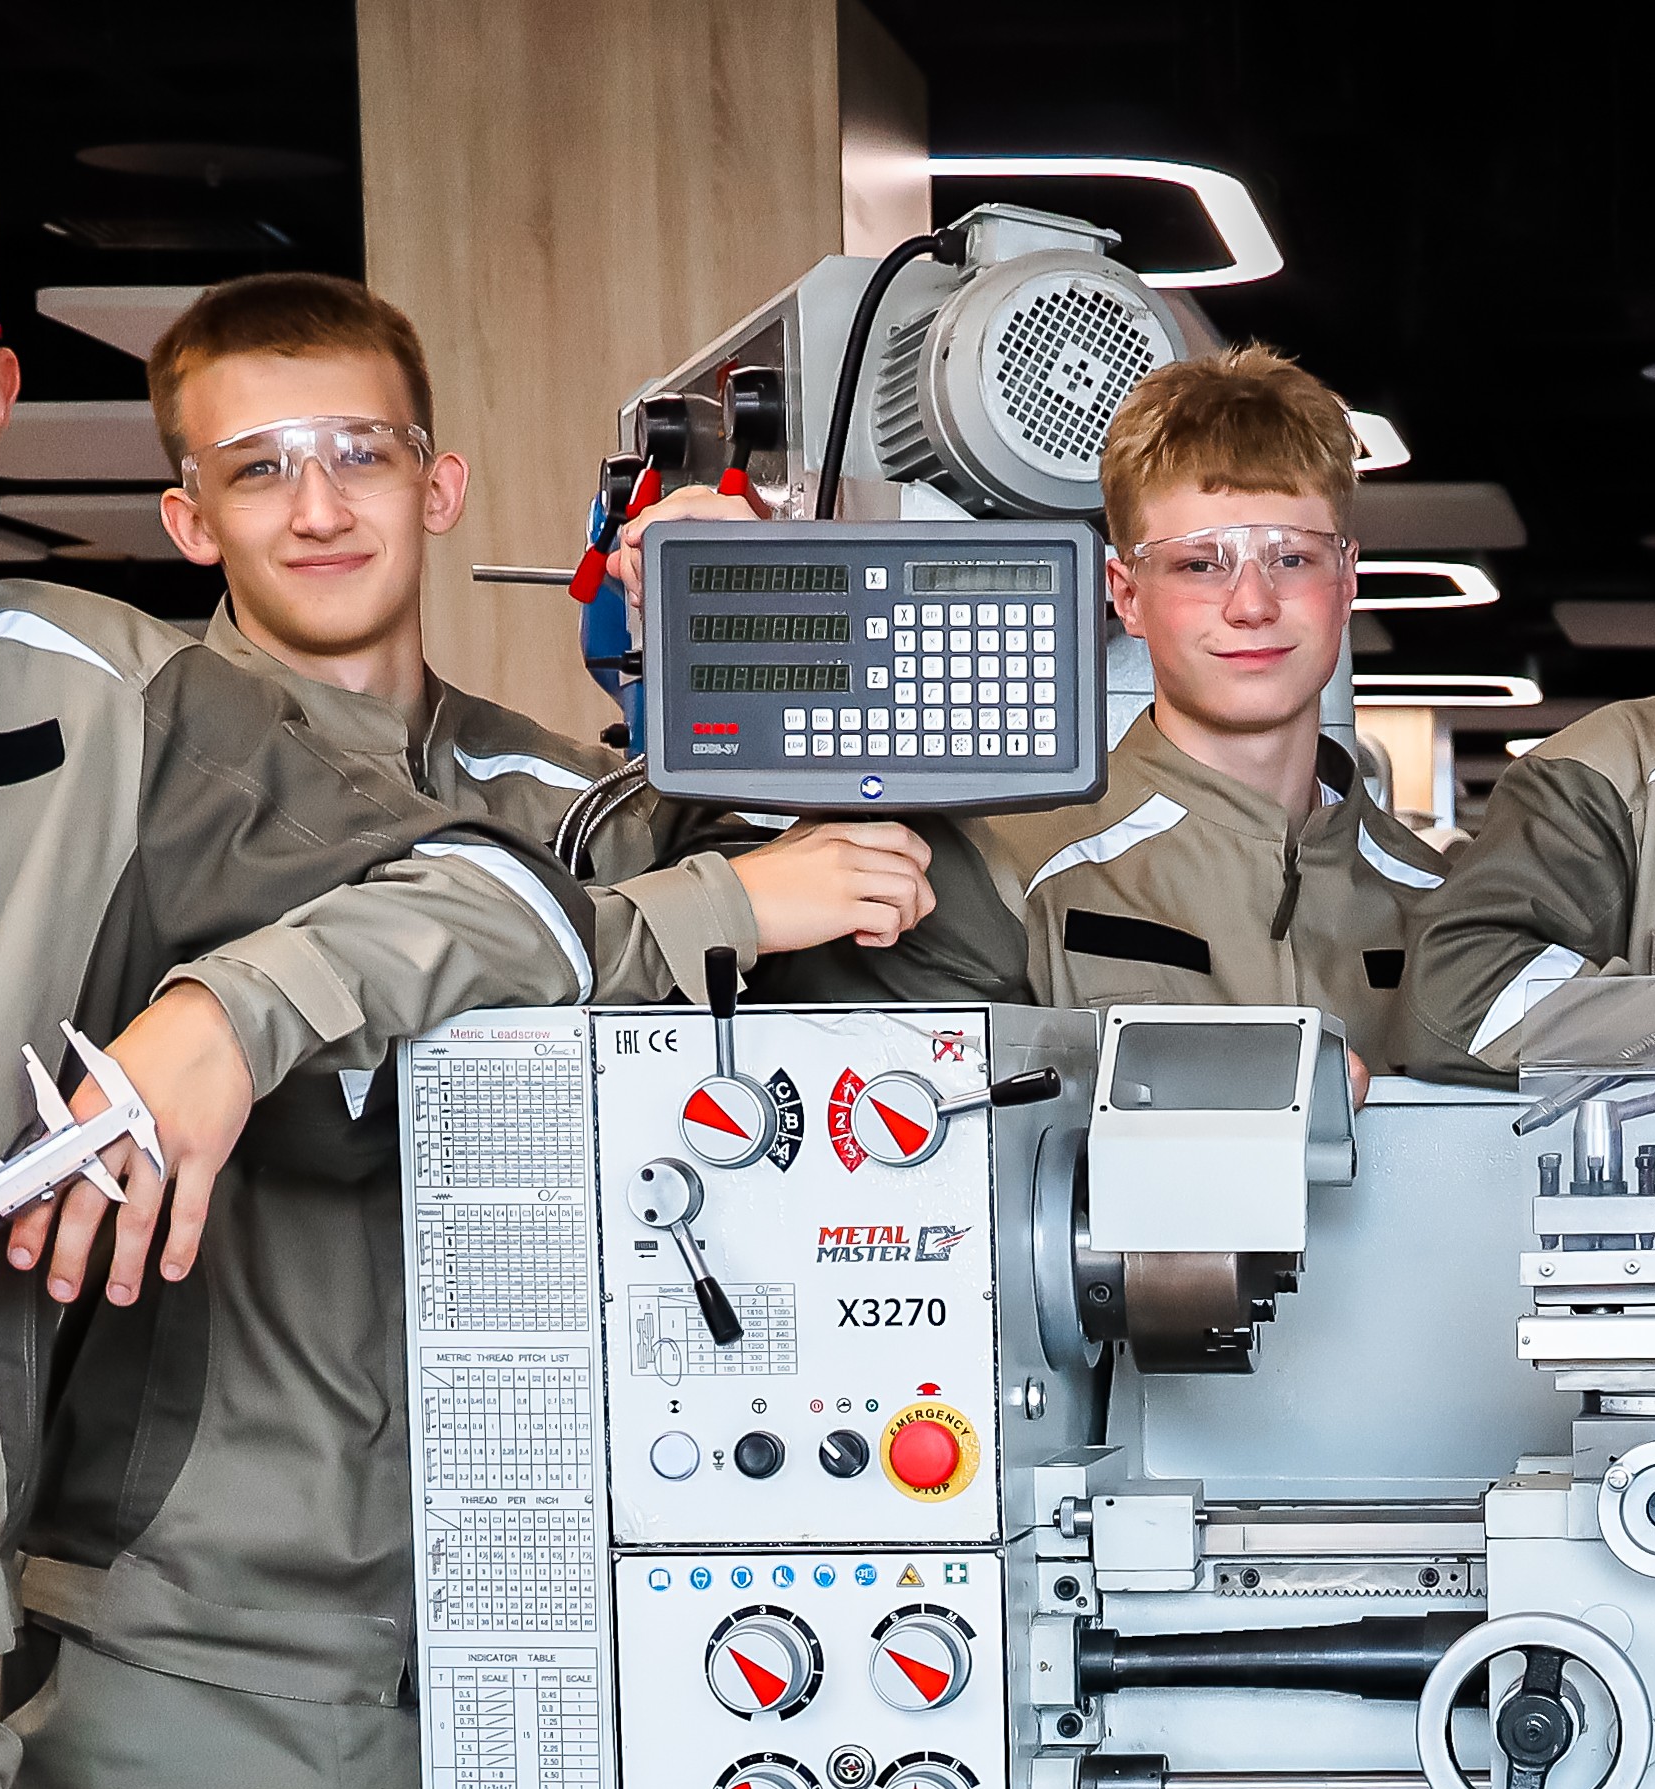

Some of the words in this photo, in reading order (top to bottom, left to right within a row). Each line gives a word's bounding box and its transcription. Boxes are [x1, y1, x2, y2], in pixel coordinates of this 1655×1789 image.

[901, 609, 908, 622] X
[901, 635, 908, 647] Y
[901, 661, 908, 673] Z
[450, 1028, 484, 1040] Metric
[490, 1029, 551, 1040] Leadscrew
[648, 1028, 678, 1053] CE
[785, 1112, 799, 1129] B
[835, 1112, 847, 1129] 2
[417, 1208, 442, 1216] Position
[818, 1225, 910, 1245] METAL
[816, 1246, 912, 1263] MASTER
[837, 1298, 947, 1327] X3270
[436, 1353, 472, 1362] METRIC
[477, 1353, 514, 1362] THREAD
[518, 1353, 546, 1362] PITCH
[550, 1353, 570, 1362] LIST
[889, 1408, 972, 1438] EMERGENCY
[460, 1496, 497, 1504] THREAD
[507, 1496, 526, 1504] PER
[535, 1496, 559, 1504] INCH
[758, 1605, 767, 1614] 3
[468, 1653, 518, 1662] INDICATOR
[527, 1654, 556, 1662] TABLE
[481, 1674, 509, 1682] SCALE
[763, 1752, 773, 1763] C
